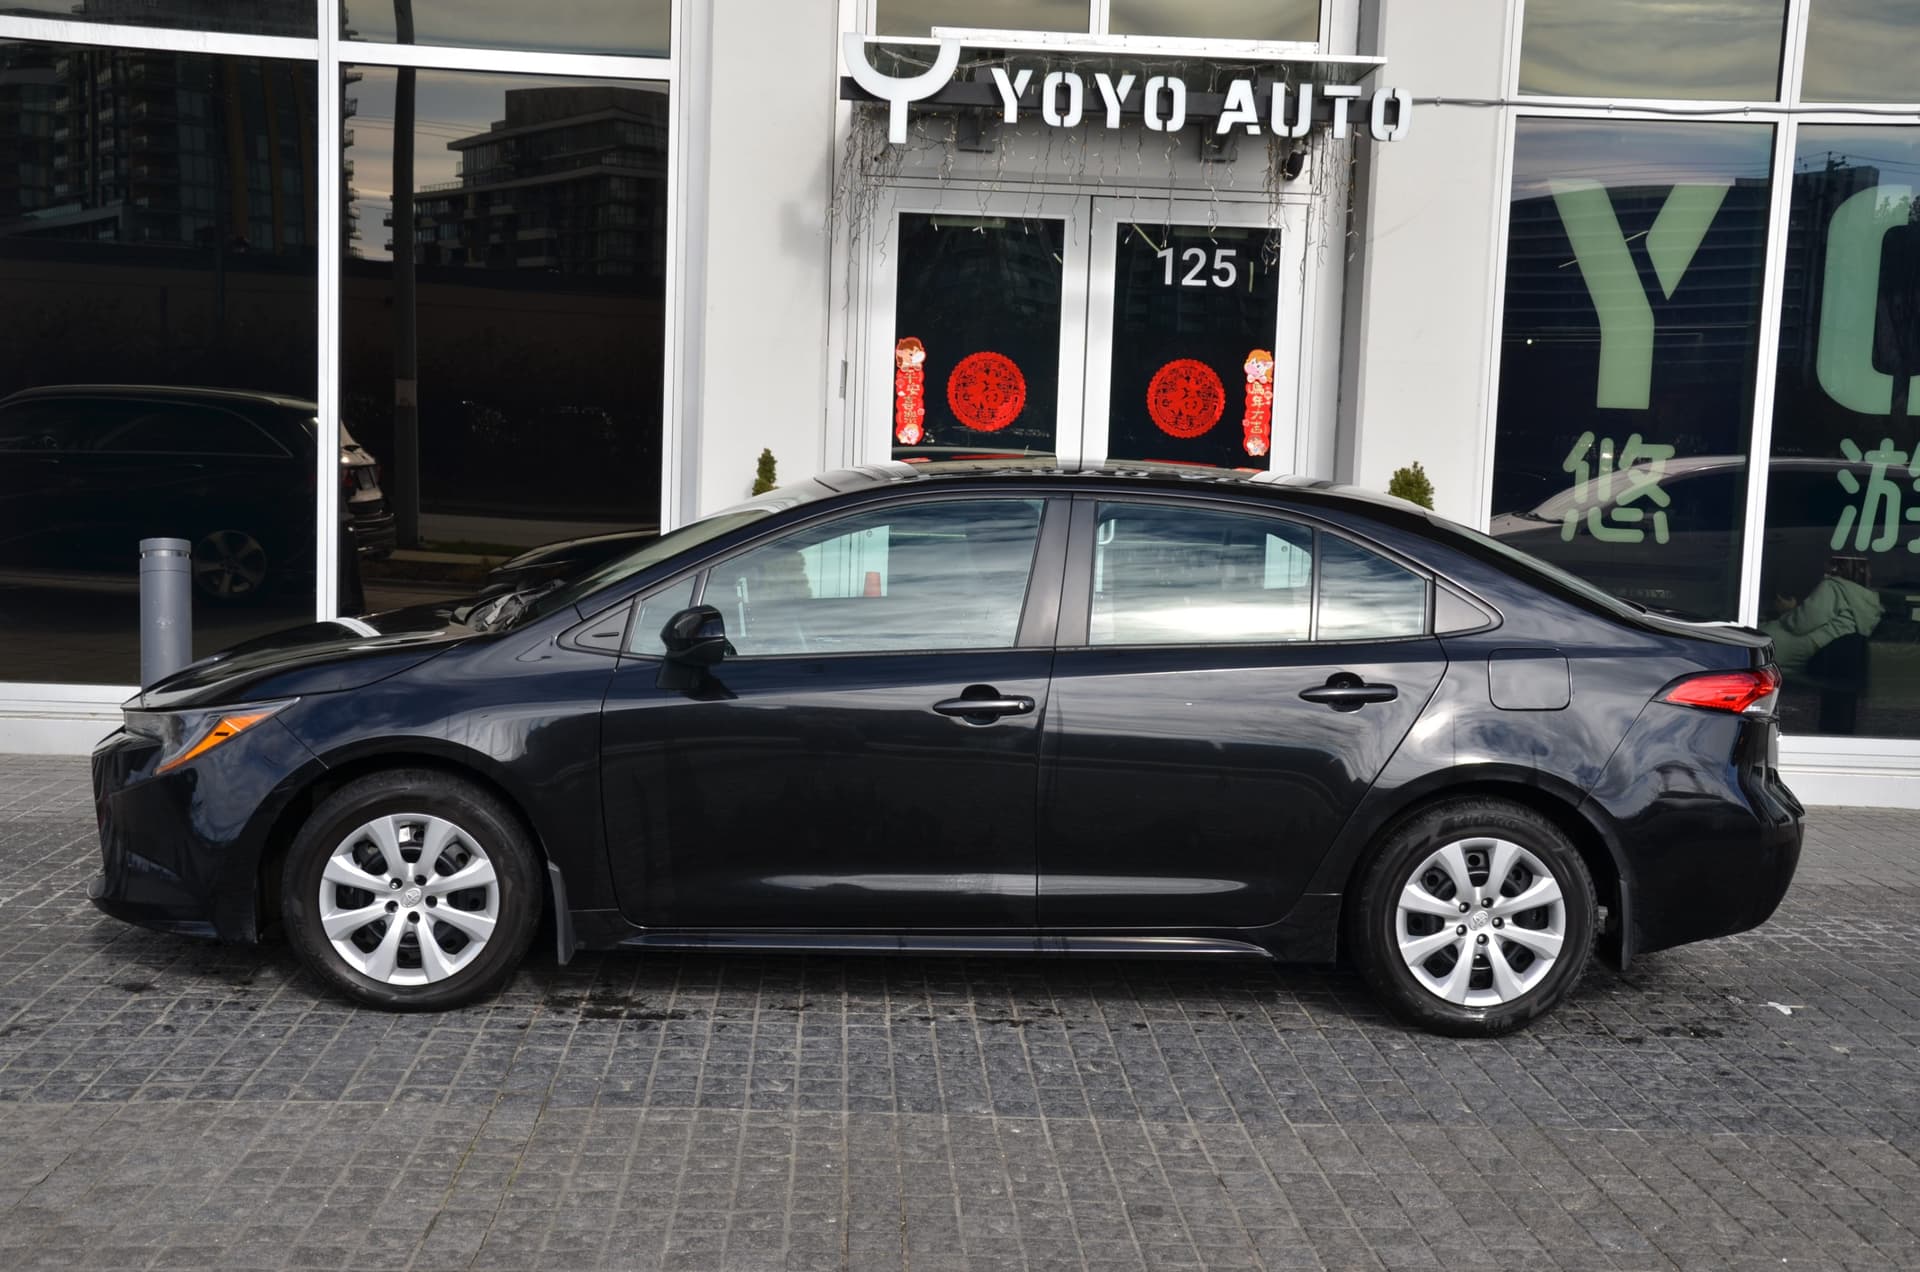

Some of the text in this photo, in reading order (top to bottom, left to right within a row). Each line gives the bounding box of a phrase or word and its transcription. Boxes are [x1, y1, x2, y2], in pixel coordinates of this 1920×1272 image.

[991, 67, 1413, 142] YOYO AUTO
[1157, 247, 1237, 288] 125
